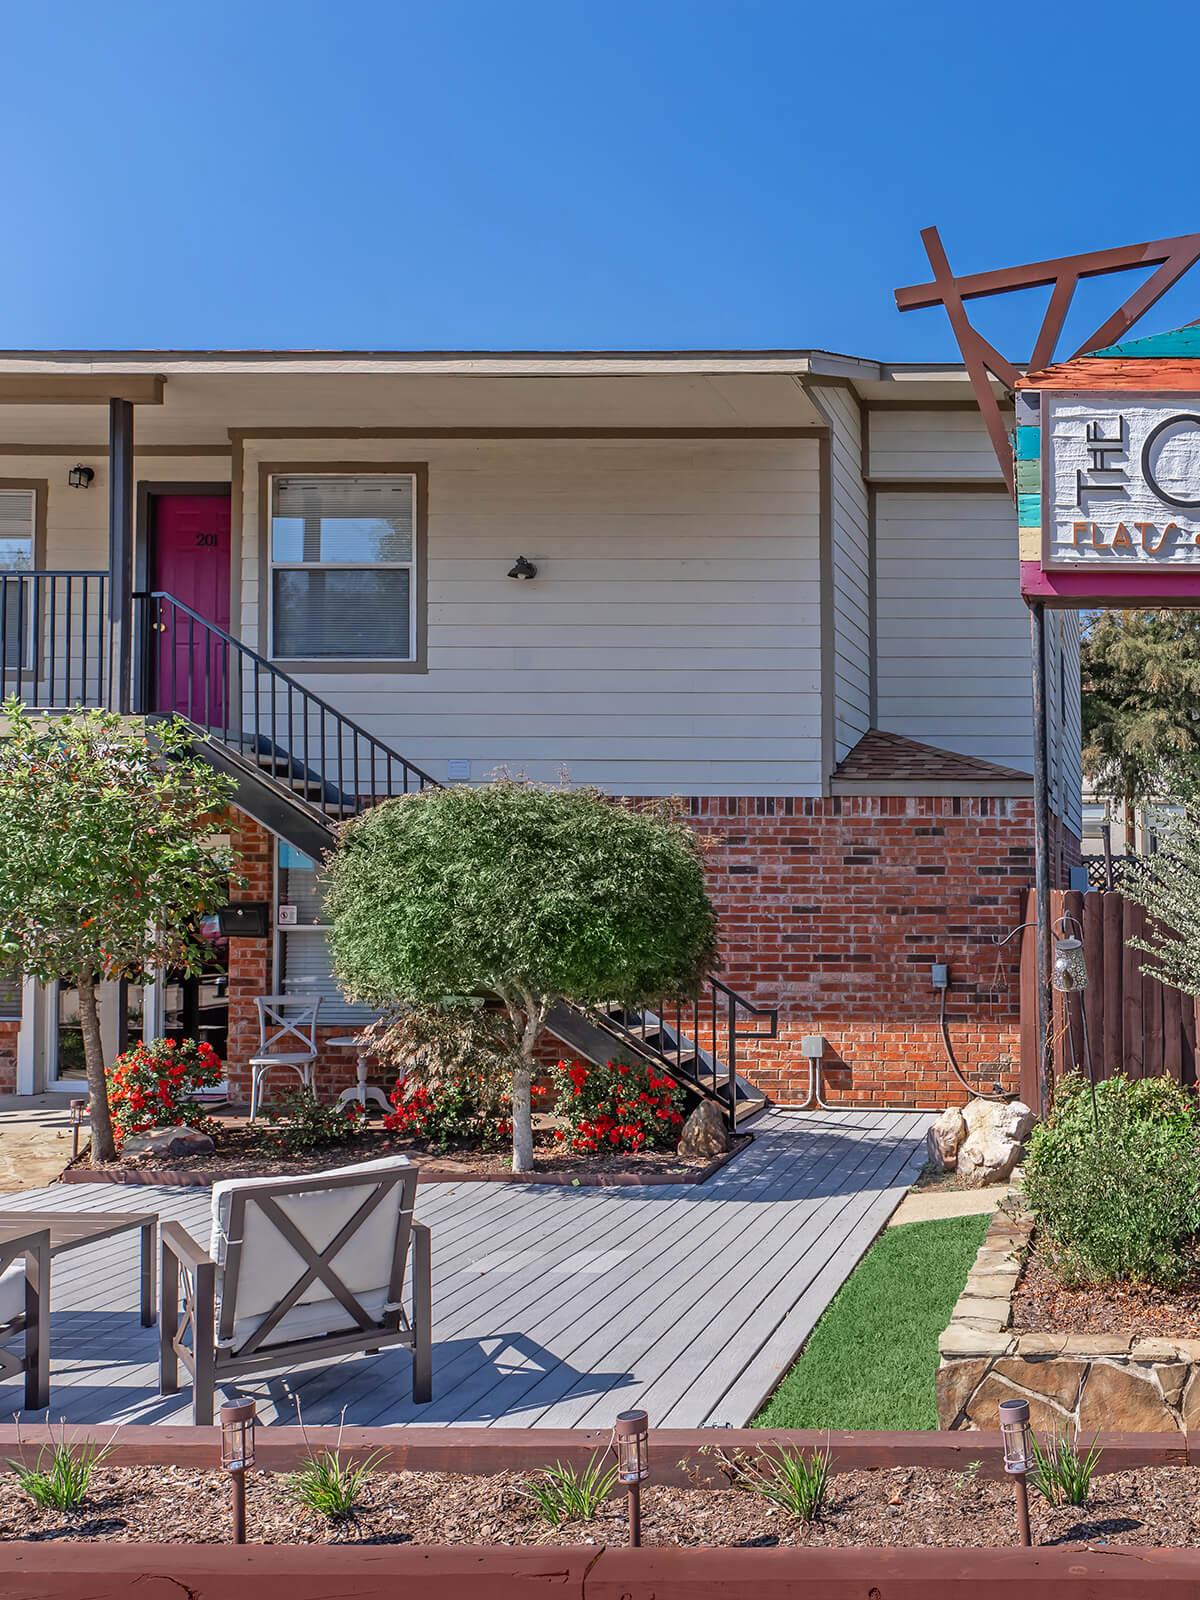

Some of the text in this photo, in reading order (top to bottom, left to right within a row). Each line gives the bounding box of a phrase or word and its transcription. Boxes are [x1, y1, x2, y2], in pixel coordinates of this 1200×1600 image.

[1076, 415, 1124, 506] THE
[195, 532, 217, 547] 201
[1072, 521, 1178, 553] FLATS
